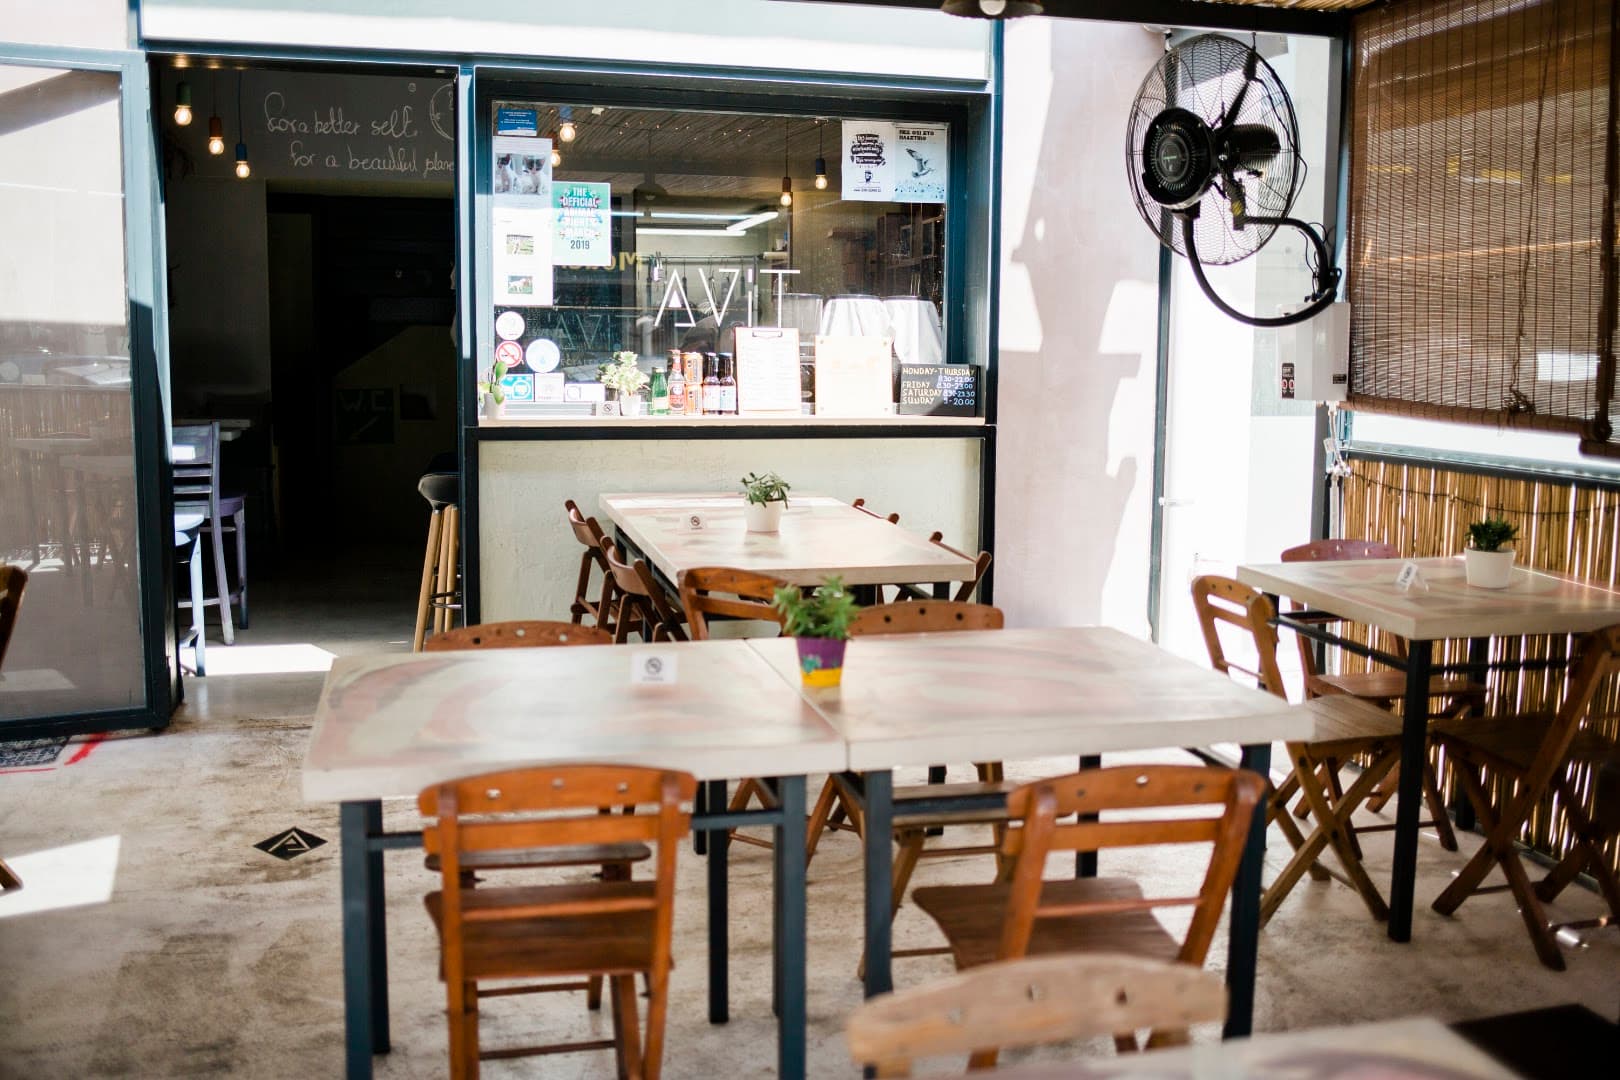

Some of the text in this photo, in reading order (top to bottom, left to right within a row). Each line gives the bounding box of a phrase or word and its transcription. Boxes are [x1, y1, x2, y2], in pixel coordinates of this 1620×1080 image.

[573, 187, 587, 196] THE
[562, 197, 599, 208] OFFICIAL
[570, 240, 590, 250] 2019
[902, 381, 930, 389] FRIDAY
[902, 389, 942, 397] SATURDAY
[902, 397, 935, 405] SUNDAY
